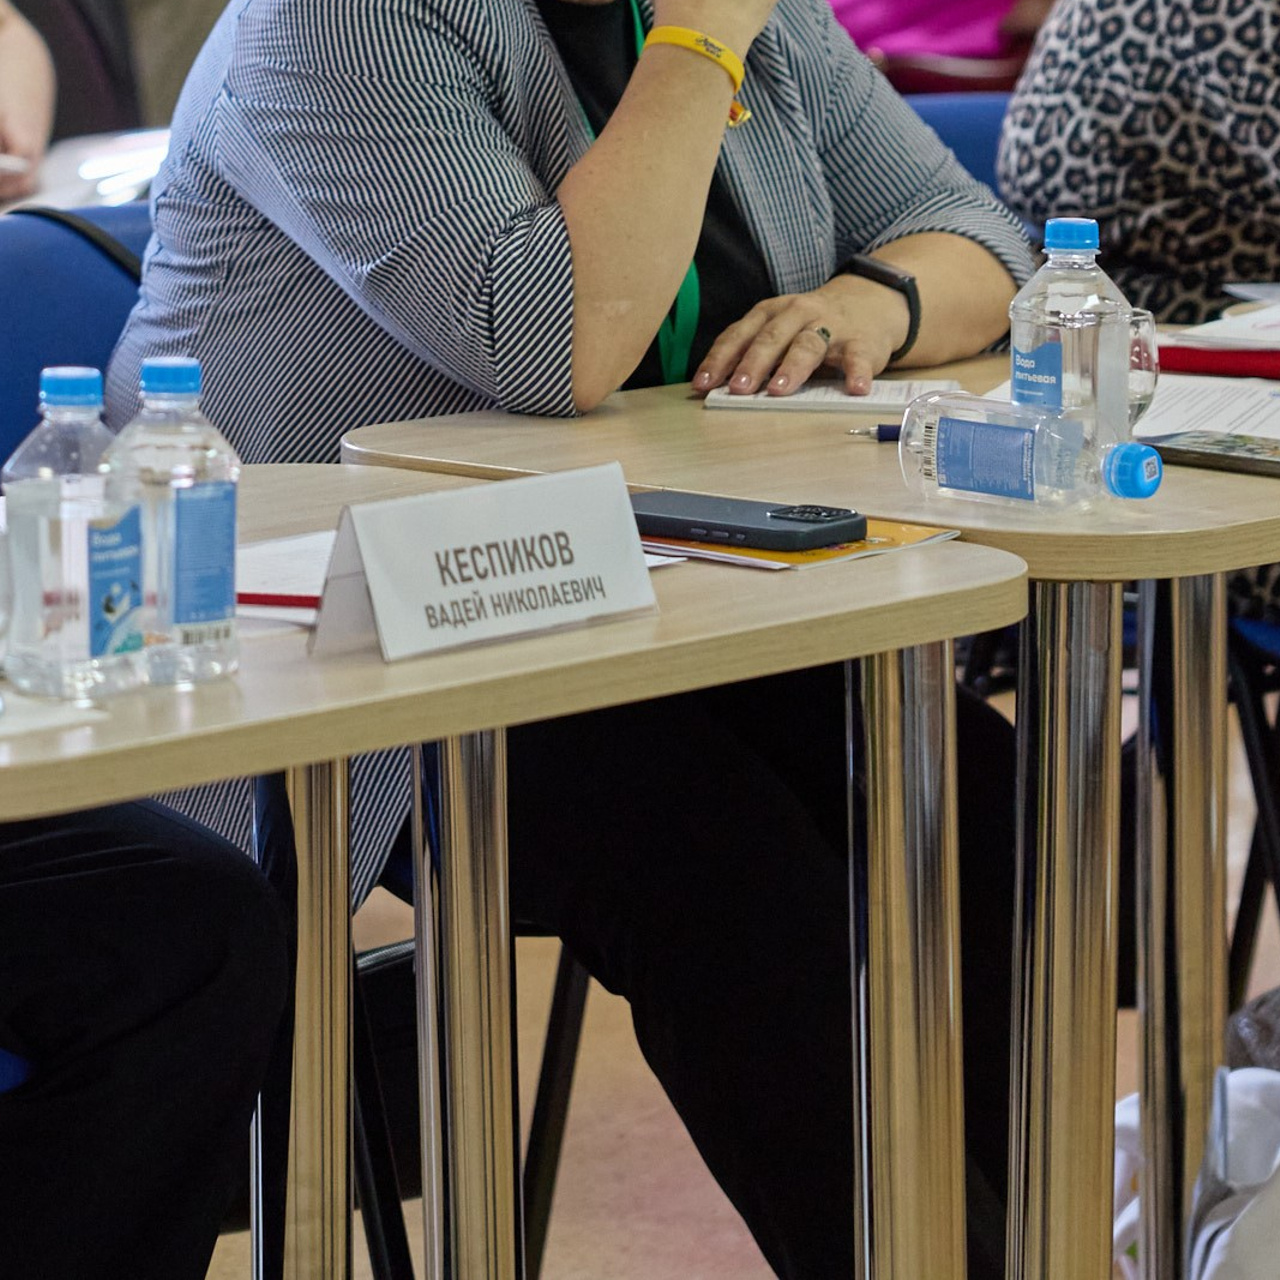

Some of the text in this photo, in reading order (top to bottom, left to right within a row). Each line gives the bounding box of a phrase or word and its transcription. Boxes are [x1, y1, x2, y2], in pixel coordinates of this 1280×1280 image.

[434, 531, 575, 587] КЕСПИКОВ
[424, 575, 607, 629] ВАДЕЙ НИКОЛАЕВИЧ
